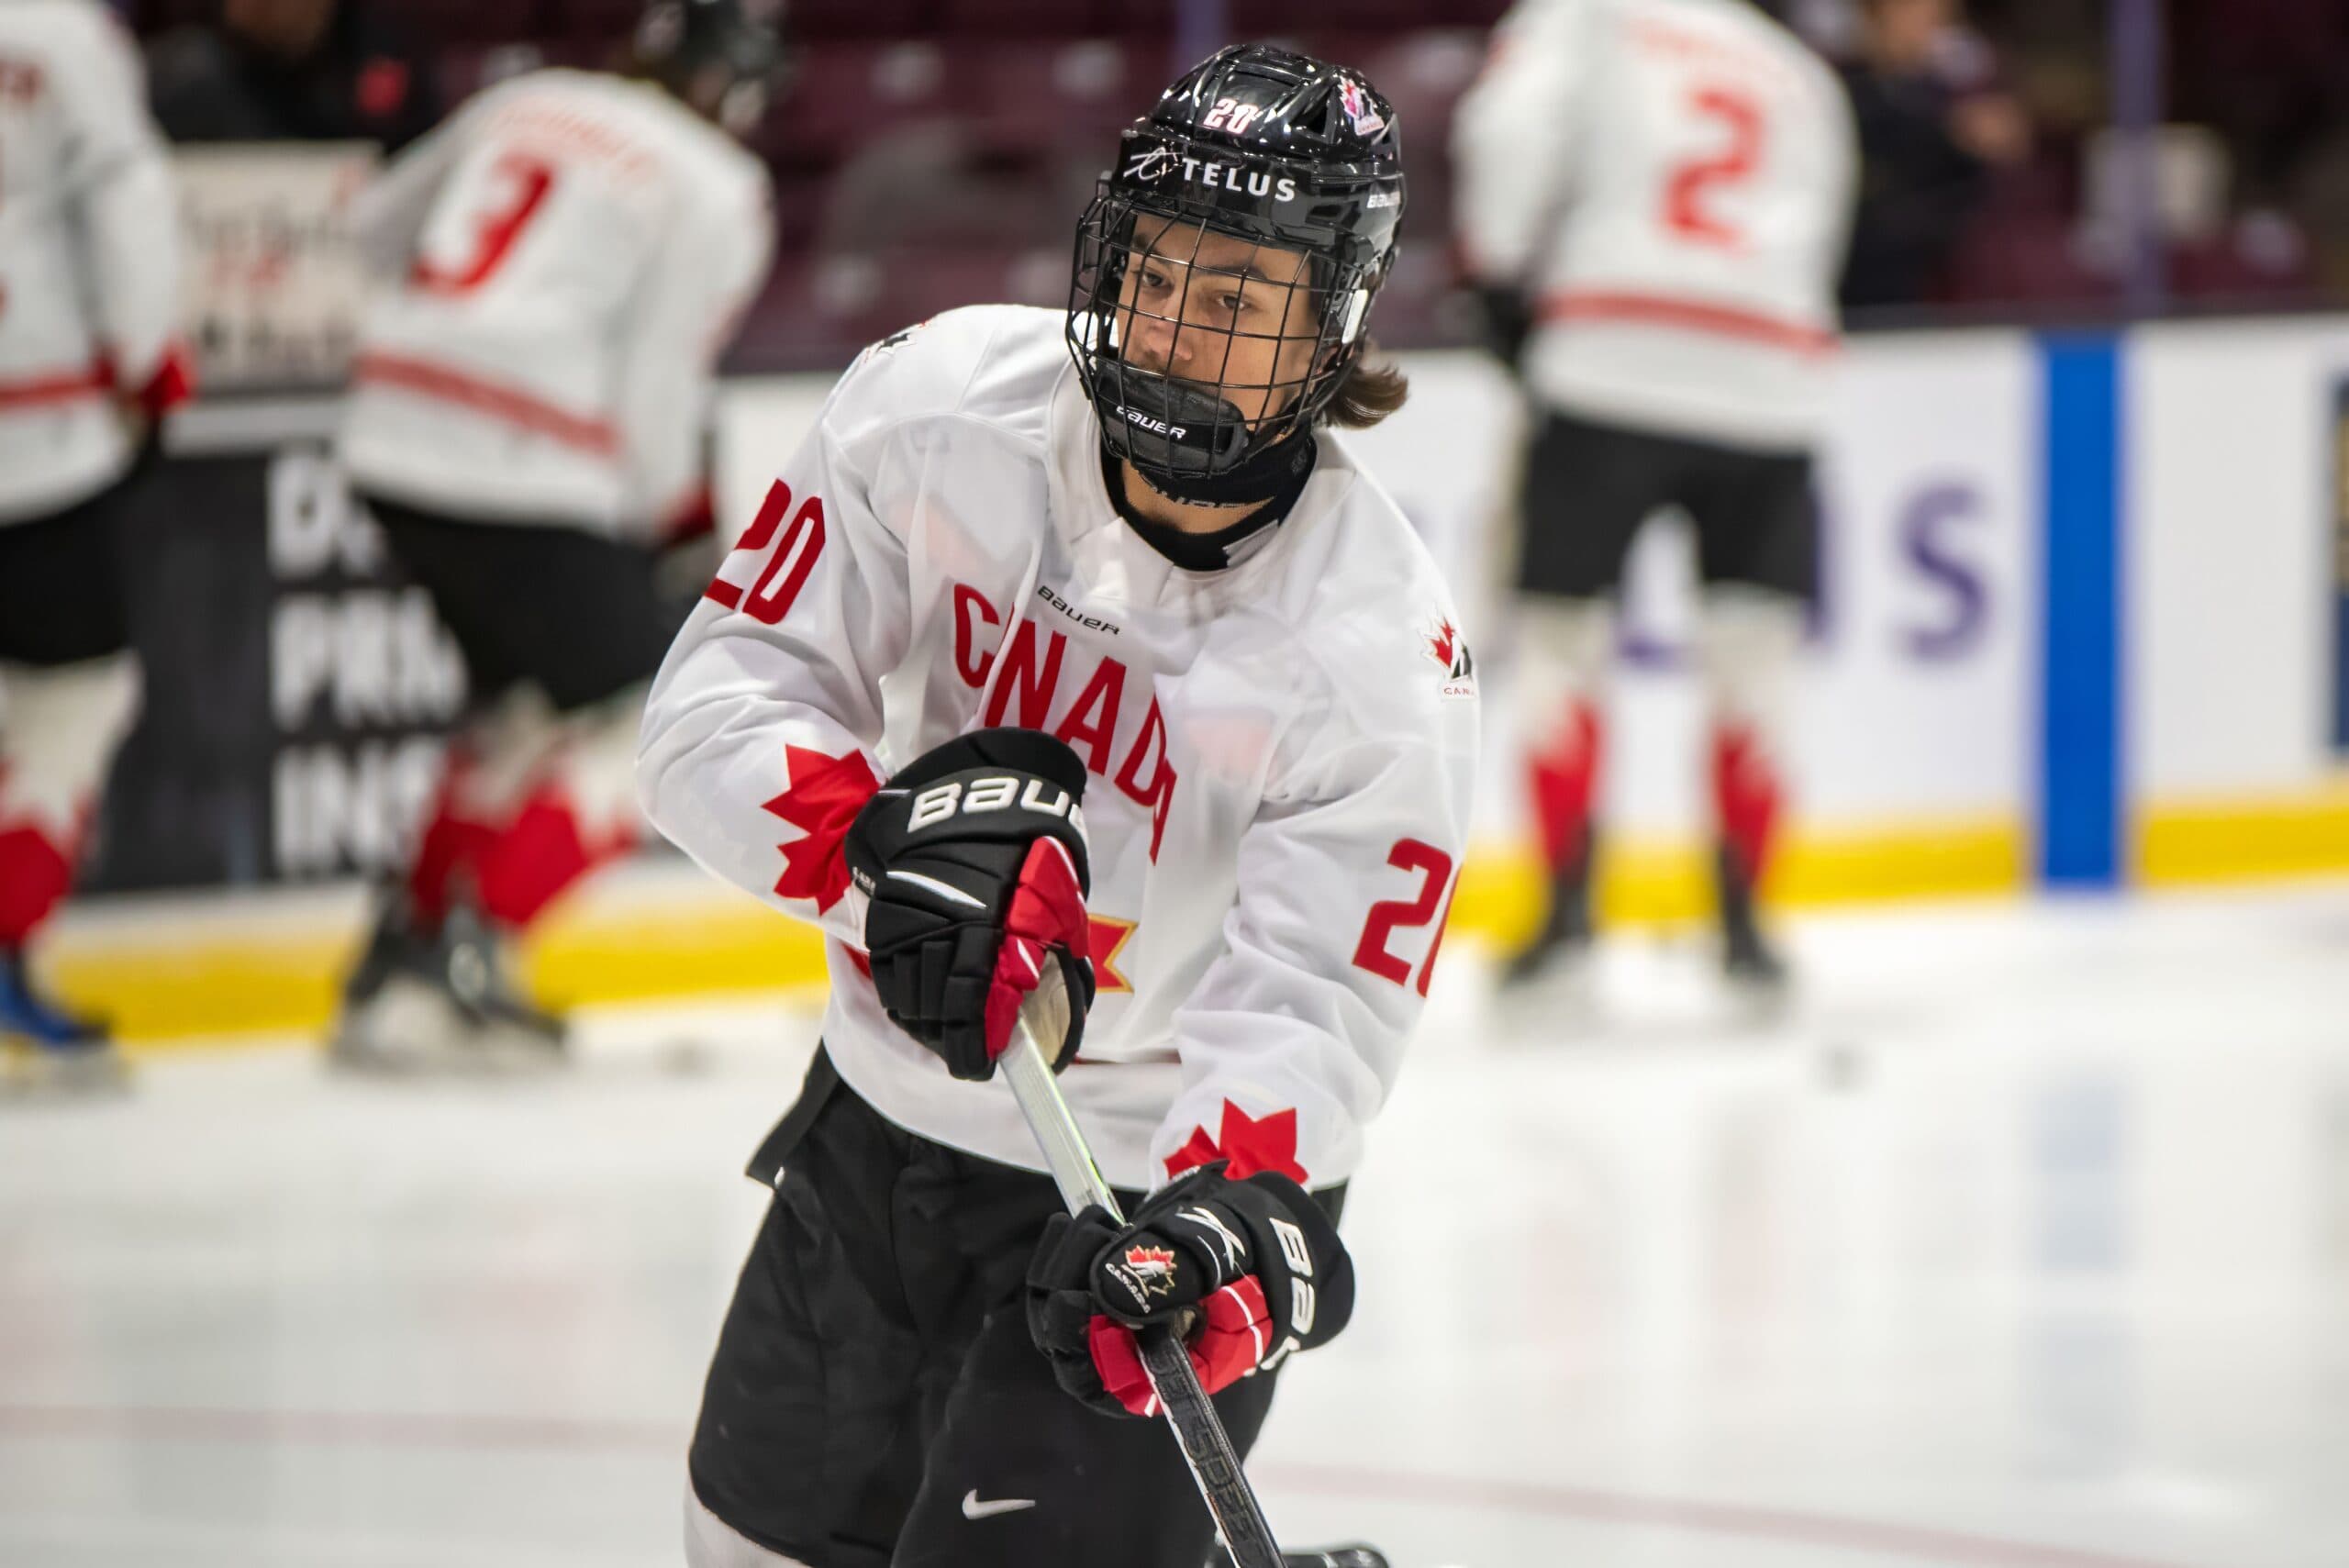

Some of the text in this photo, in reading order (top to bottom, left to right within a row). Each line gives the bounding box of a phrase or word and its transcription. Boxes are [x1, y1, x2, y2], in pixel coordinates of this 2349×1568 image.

[1203, 98, 1260, 135] 20
[410, 151, 554, 297] 3
[1182, 158, 1297, 202] TELUS
[703, 478, 826, 625] 20
[954, 583, 1178, 866] CNAD
[1443, 687, 1475, 695] CAN
[907, 777, 1090, 833] BAU
[1353, 838, 1464, 998] 2
